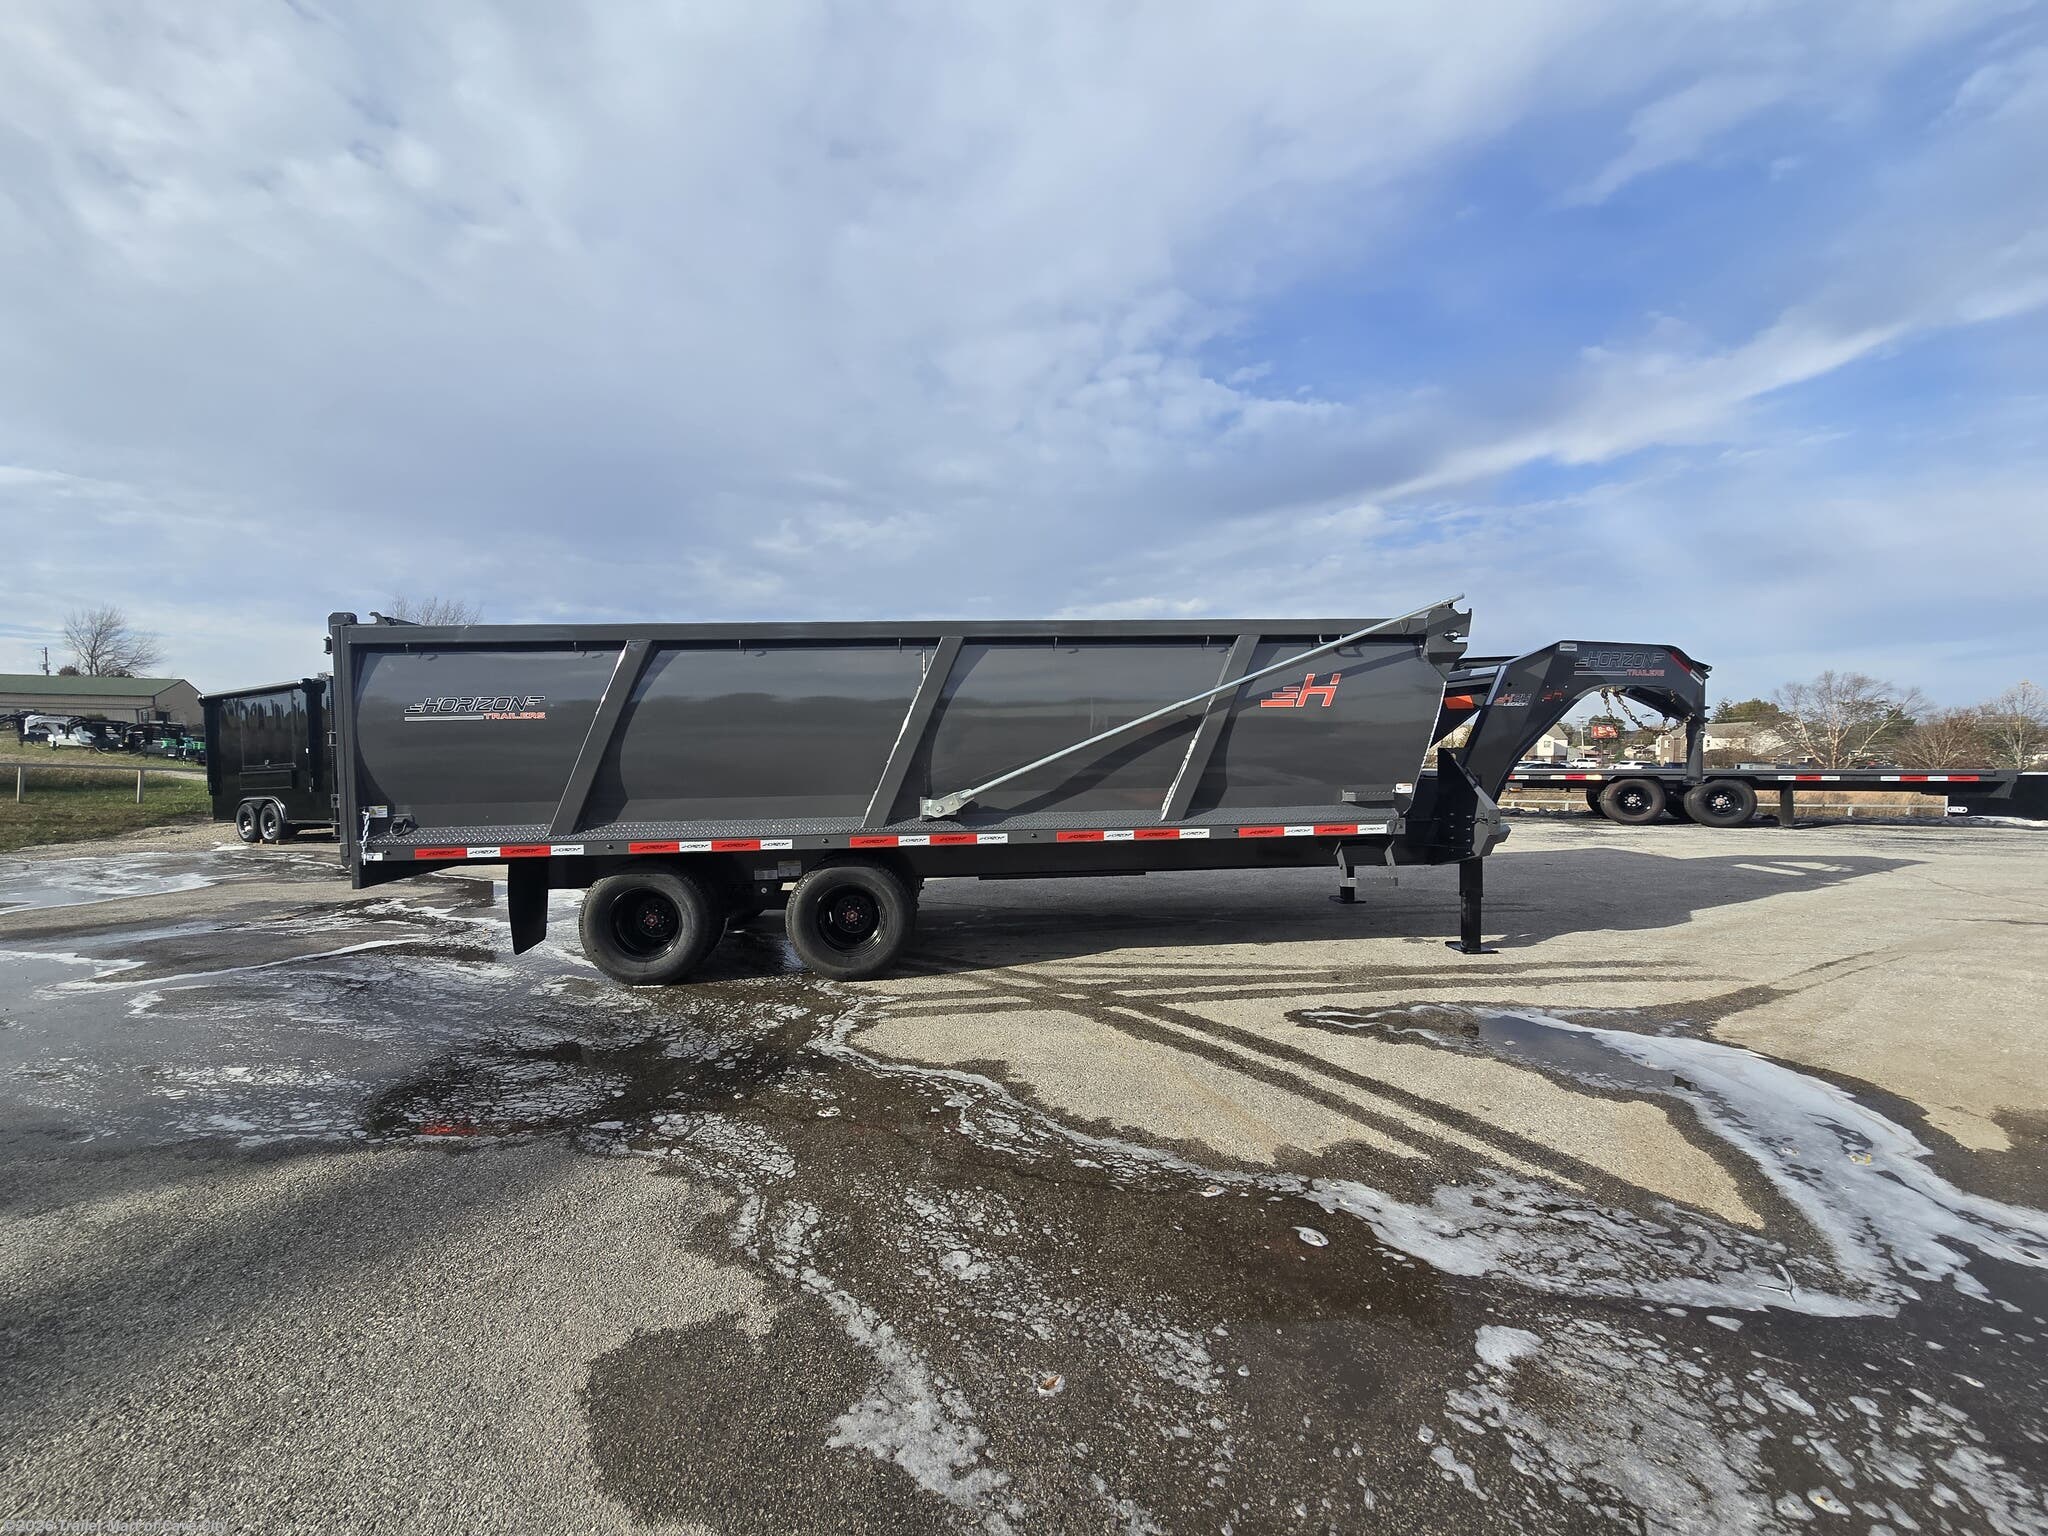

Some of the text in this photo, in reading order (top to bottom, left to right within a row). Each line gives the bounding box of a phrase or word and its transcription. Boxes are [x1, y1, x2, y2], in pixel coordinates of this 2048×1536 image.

[1586, 651, 1656, 669] HORIZON
[1626, 669, 1665, 677] TRAILERS
[421, 695, 530, 713] HORIZON
[483, 712, 546, 720] TRAILERS
